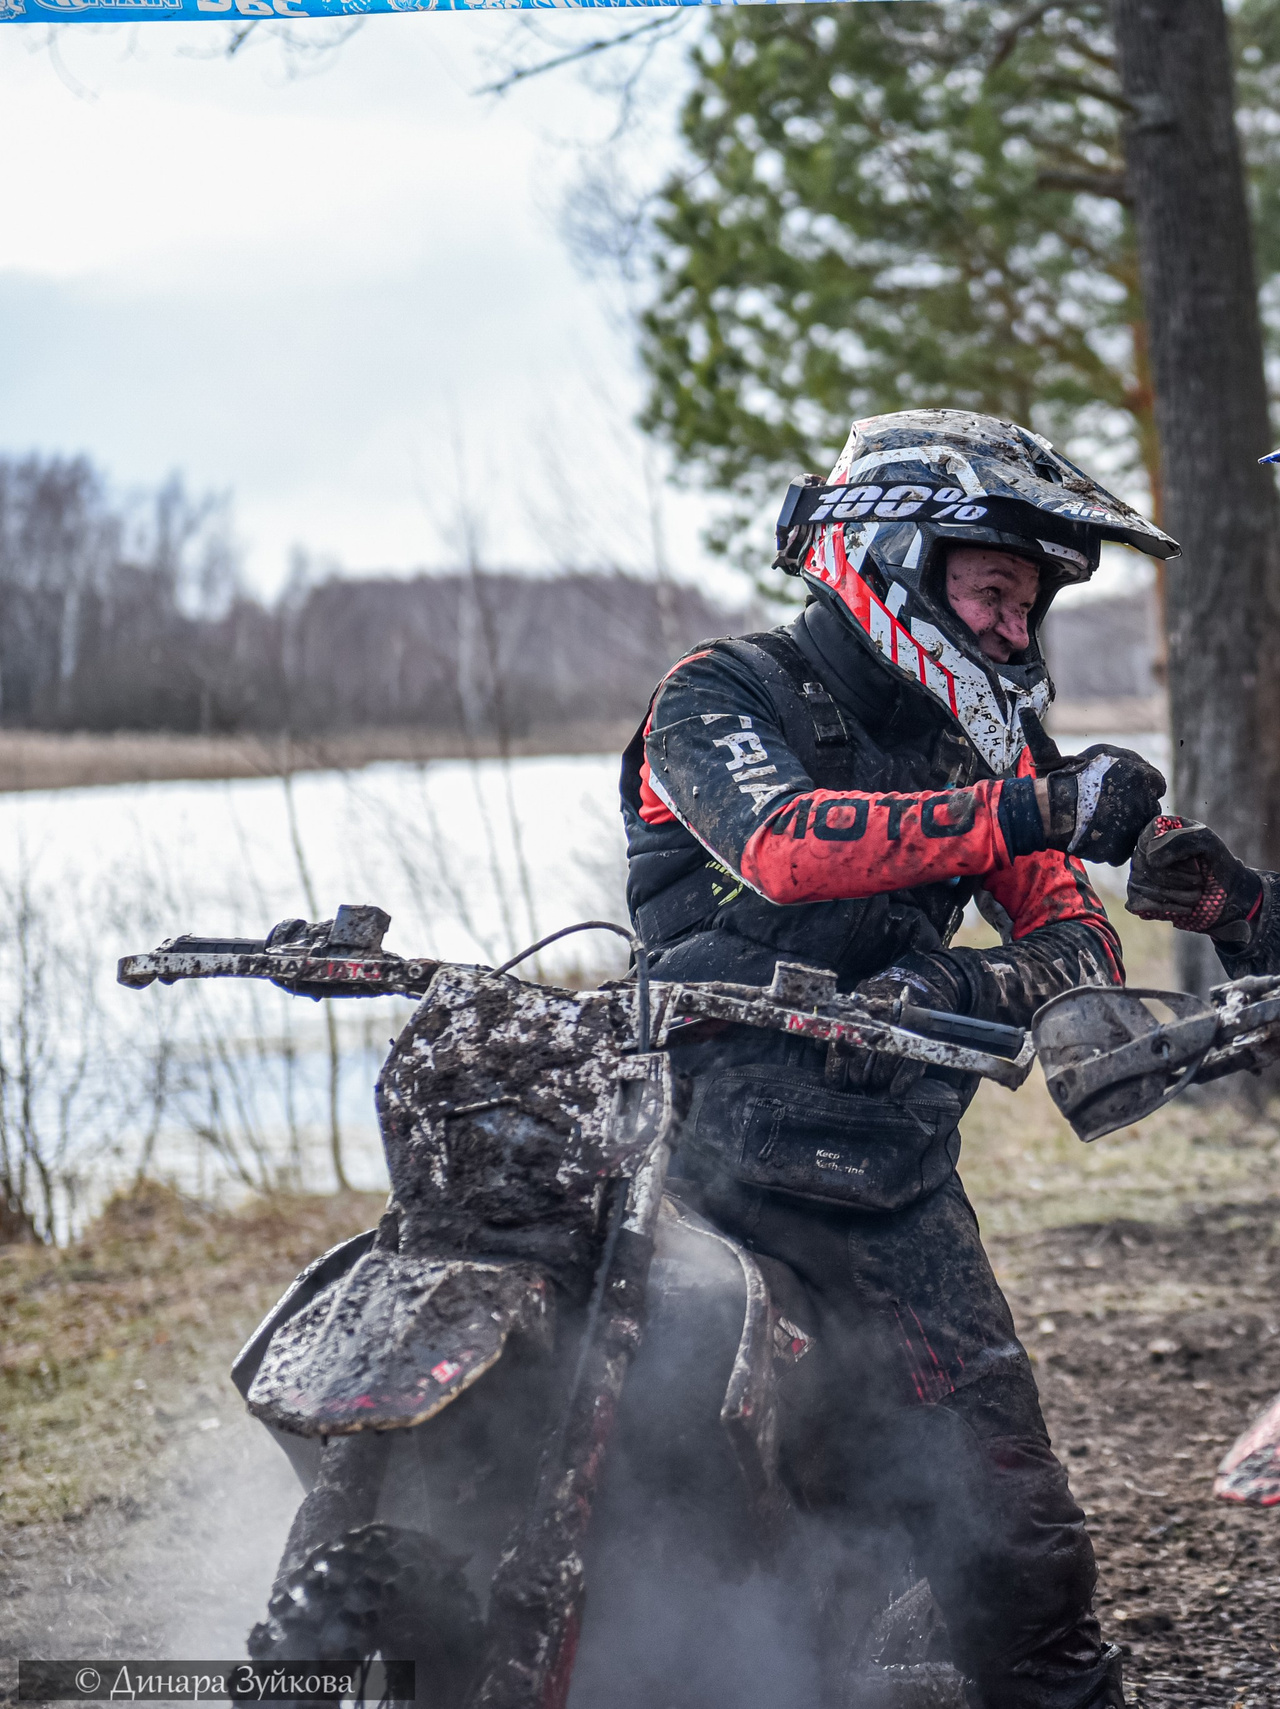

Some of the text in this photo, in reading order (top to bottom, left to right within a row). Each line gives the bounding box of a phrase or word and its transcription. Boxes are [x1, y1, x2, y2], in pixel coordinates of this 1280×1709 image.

[808, 484, 988, 521] 100%
[816, 1149, 840, 1160] Keep
[815, 1159, 865, 1176] Kathrine
